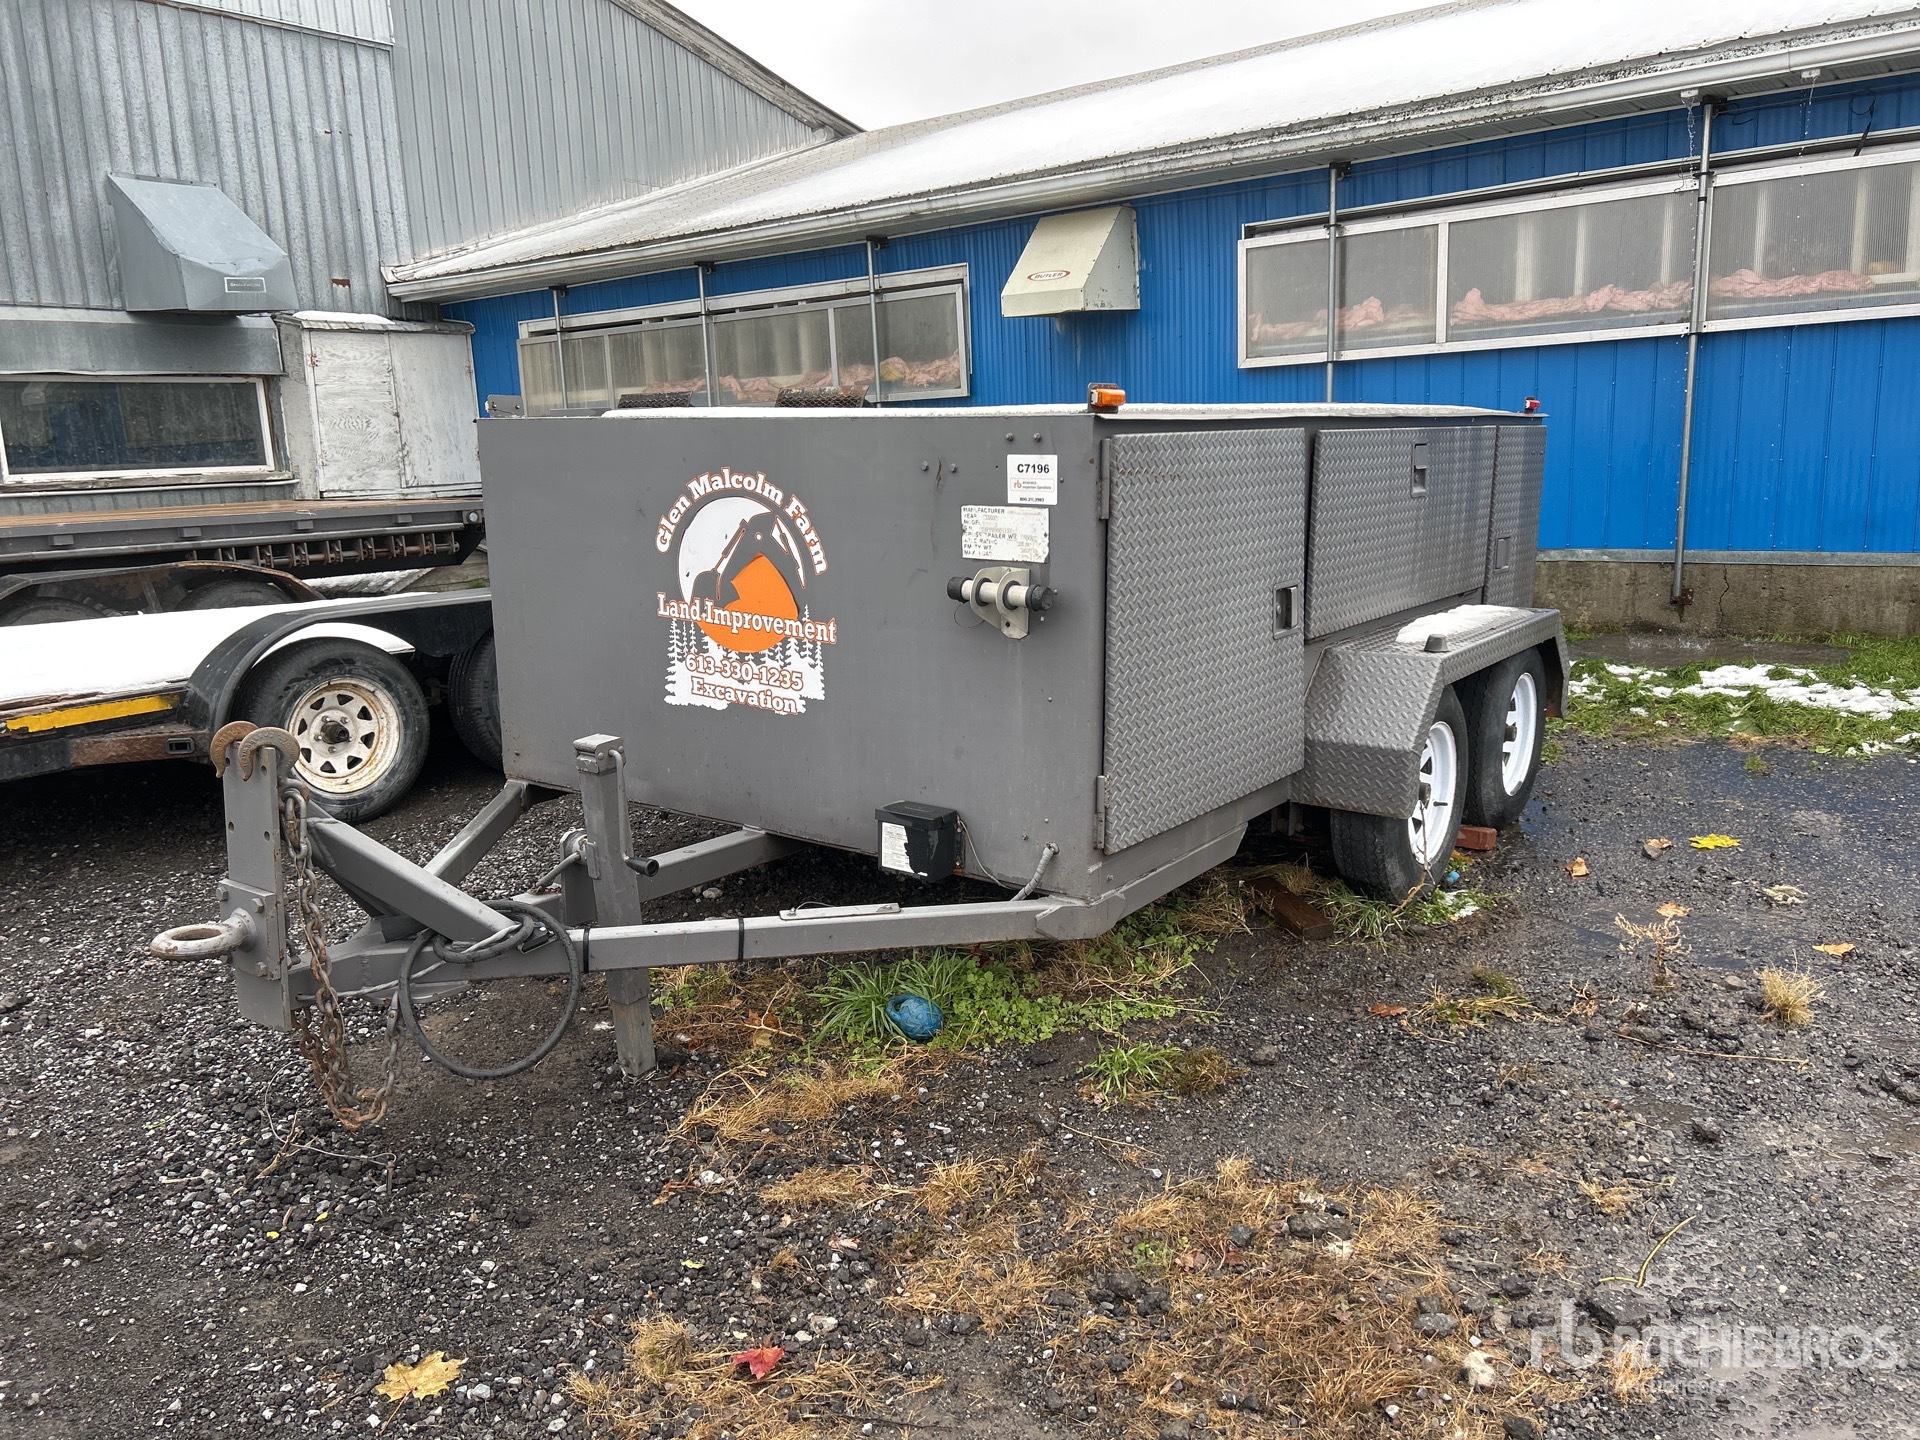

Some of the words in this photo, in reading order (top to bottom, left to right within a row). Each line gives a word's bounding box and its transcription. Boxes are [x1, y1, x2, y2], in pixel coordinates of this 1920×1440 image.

[1017, 463, 1050, 473] C7196
[656, 494, 692, 554] Glen
[686, 466, 784, 506] Malcolm
[783, 494, 828, 576] Farm
[657, 592, 702, 622] Land
[704, 598, 837, 644] Improvement
[685, 652, 804, 691] 613-330-1235
[691, 676, 799, 715] Excavation
